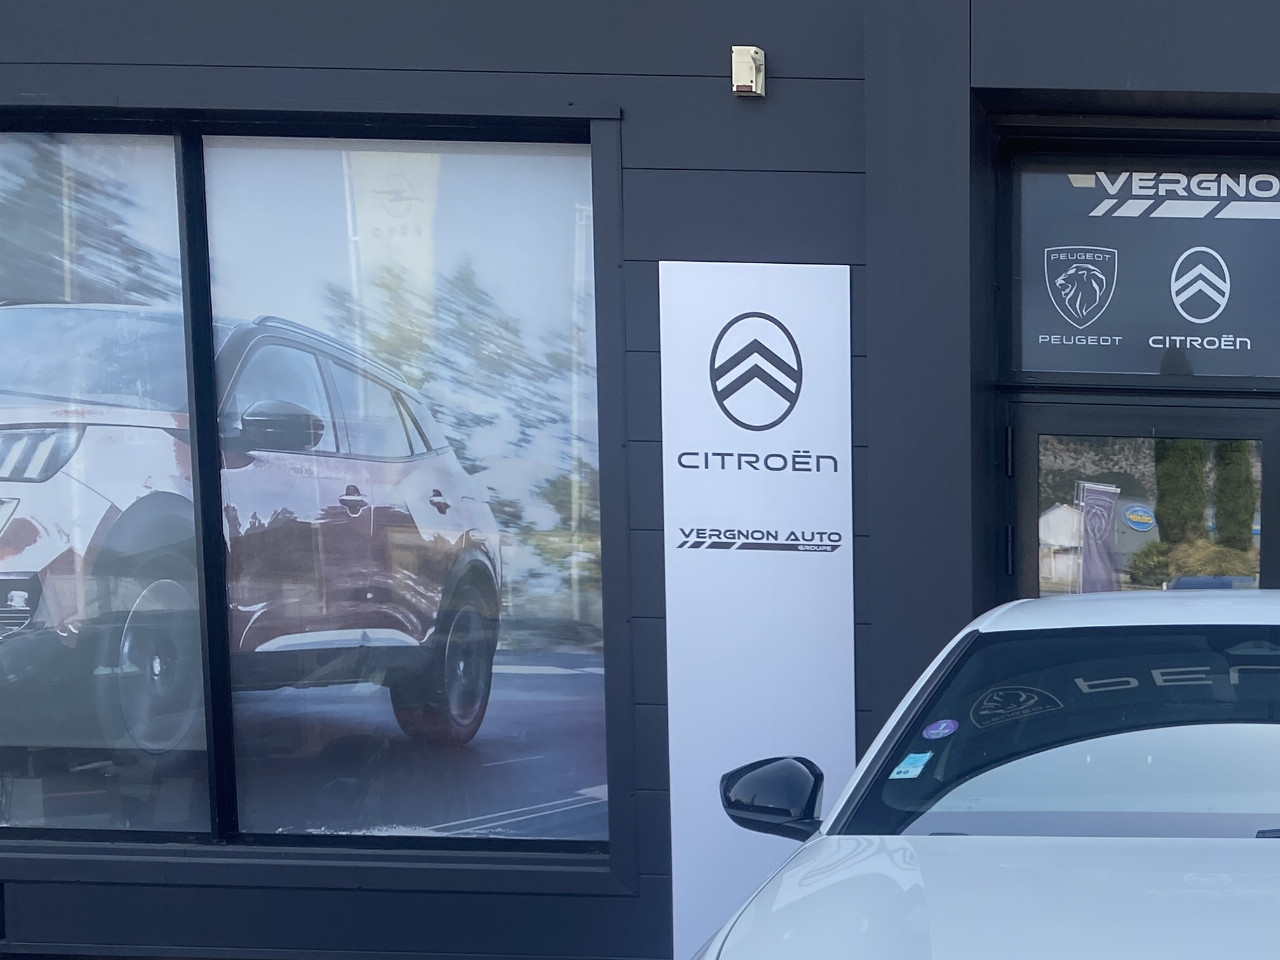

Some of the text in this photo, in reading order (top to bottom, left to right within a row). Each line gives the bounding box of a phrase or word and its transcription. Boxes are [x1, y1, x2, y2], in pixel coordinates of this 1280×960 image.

[1050, 252, 1111, 262] PEUGEOT
[1038, 334, 1122, 346] PEUGEOT
[1148, 333, 1251, 350] CITROËN
[677, 450, 838, 473] CITROËN
[679, 528, 842, 543] VERGNON AUTO
